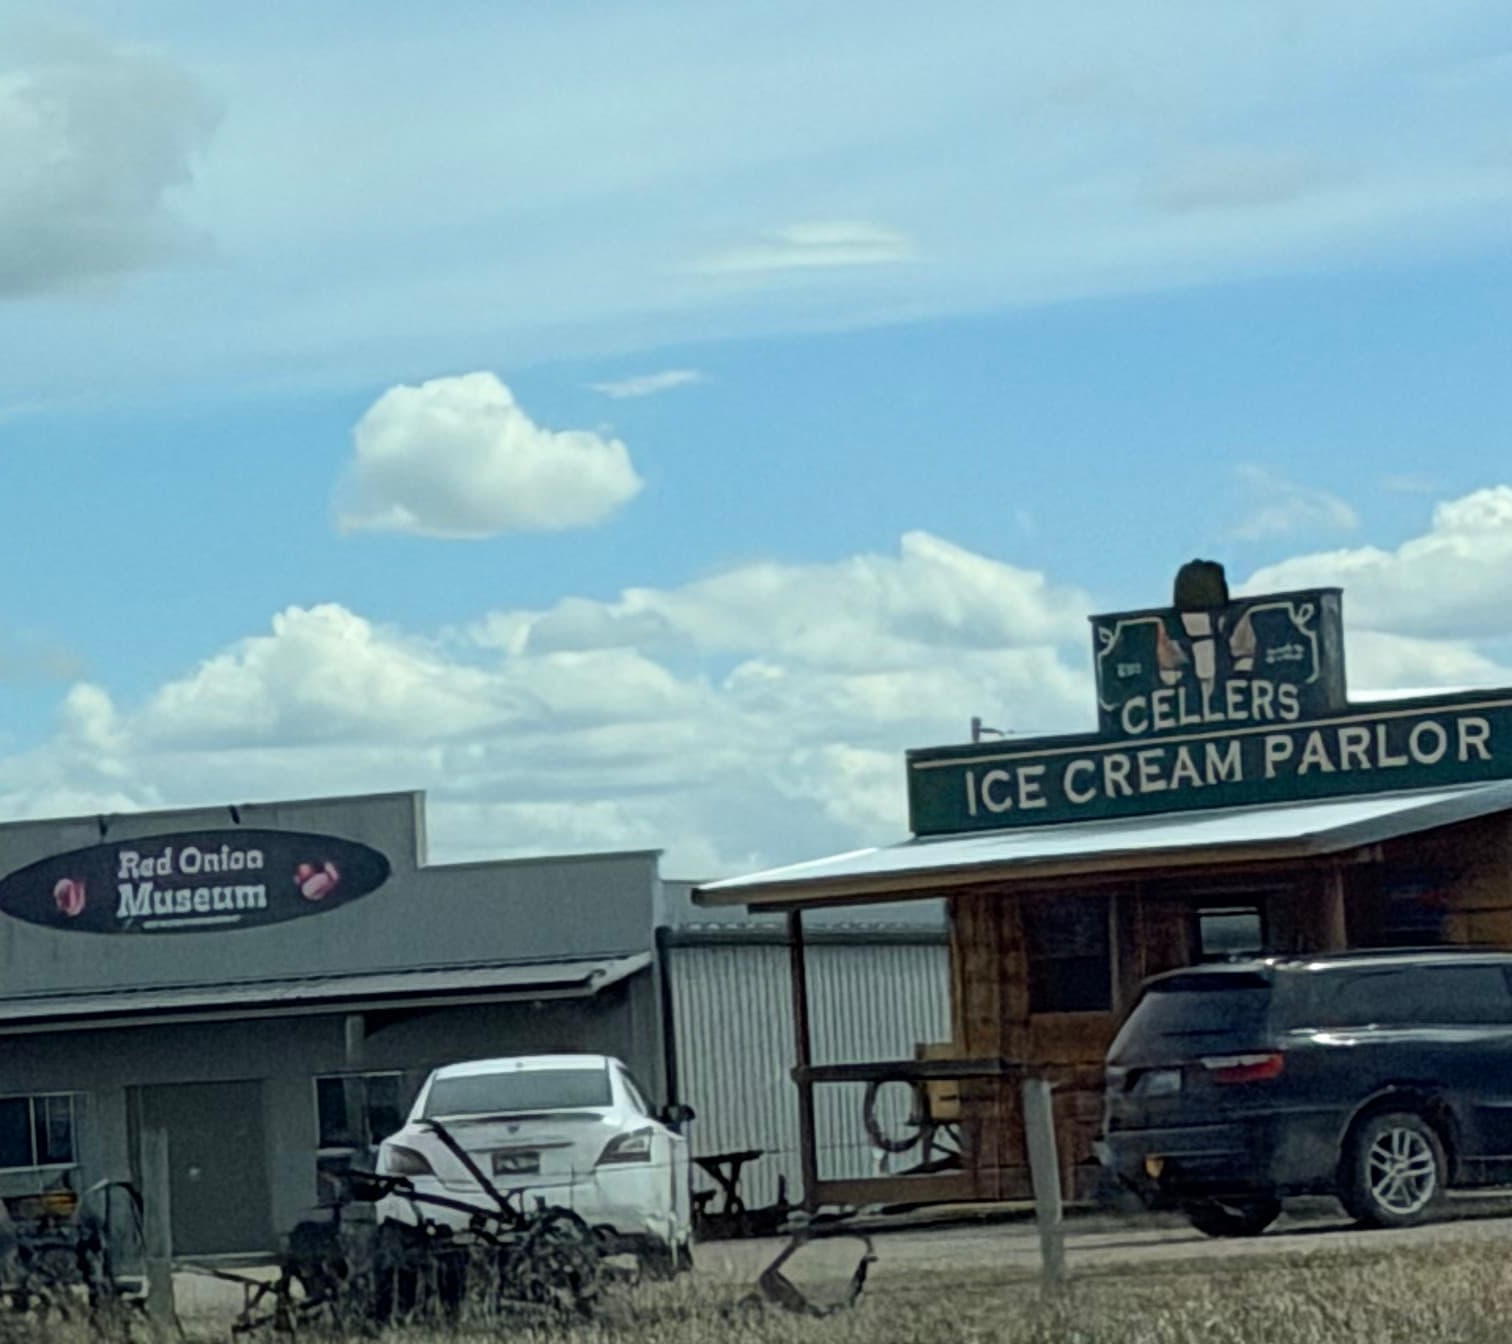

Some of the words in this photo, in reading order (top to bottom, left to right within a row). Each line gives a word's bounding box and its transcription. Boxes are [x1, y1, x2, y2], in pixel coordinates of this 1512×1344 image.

[1121, 679, 1300, 734] CELLERS
[965, 765, 1047, 816] ICE
[1063, 740, 1243, 803] CREAM
[1264, 717, 1492, 778] PARLOR
[118, 847, 172, 879] Red
[179, 844, 263, 874] Onion
[116, 881, 267, 918] Museum
